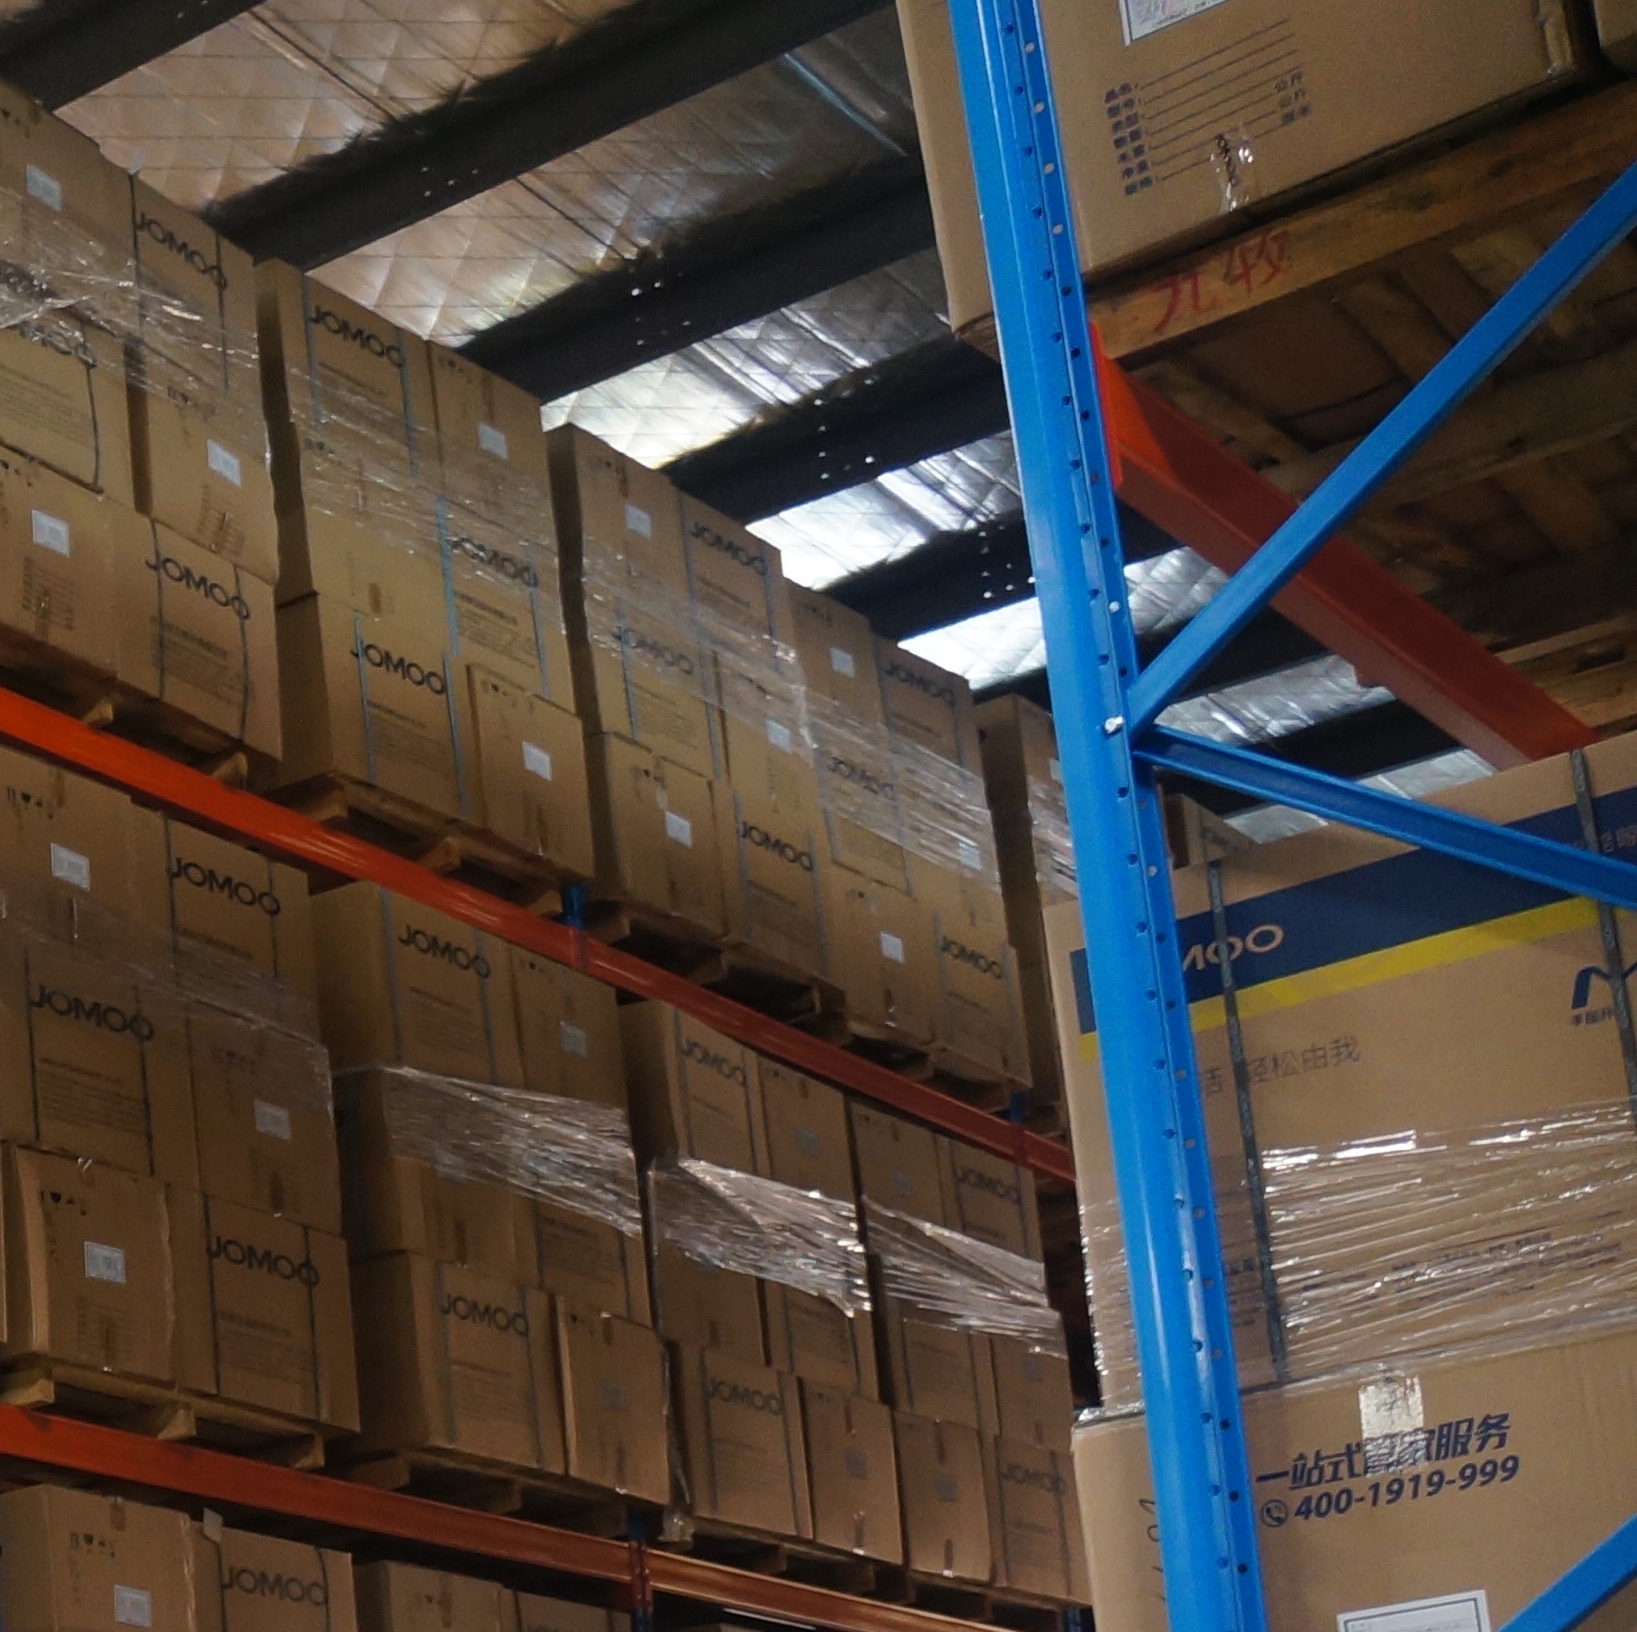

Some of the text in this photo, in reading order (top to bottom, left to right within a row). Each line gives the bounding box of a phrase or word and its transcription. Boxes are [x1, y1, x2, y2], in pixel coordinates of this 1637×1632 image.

[134, 212, 227, 291] JOMOO
[306, 305, 405, 368] JOMOO
[146, 553, 250, 622] JOMOO
[351, 639, 447, 696] JOMOO
[740, 821, 814, 872] JOMOO
[171, 857, 280, 917] JOMOO
[398, 925, 491, 979] JOMOO
[1183, 924, 1285, 972] MOO
[33, 984, 154, 1042] JOMOO
[209, 1236, 320, 1287] JOMOO
[441, 1294, 527, 1338] JOMOO
[1294, 1455, 1520, 1521] 400-1919-999
[222, 1564, 325, 1608] JOMOO
